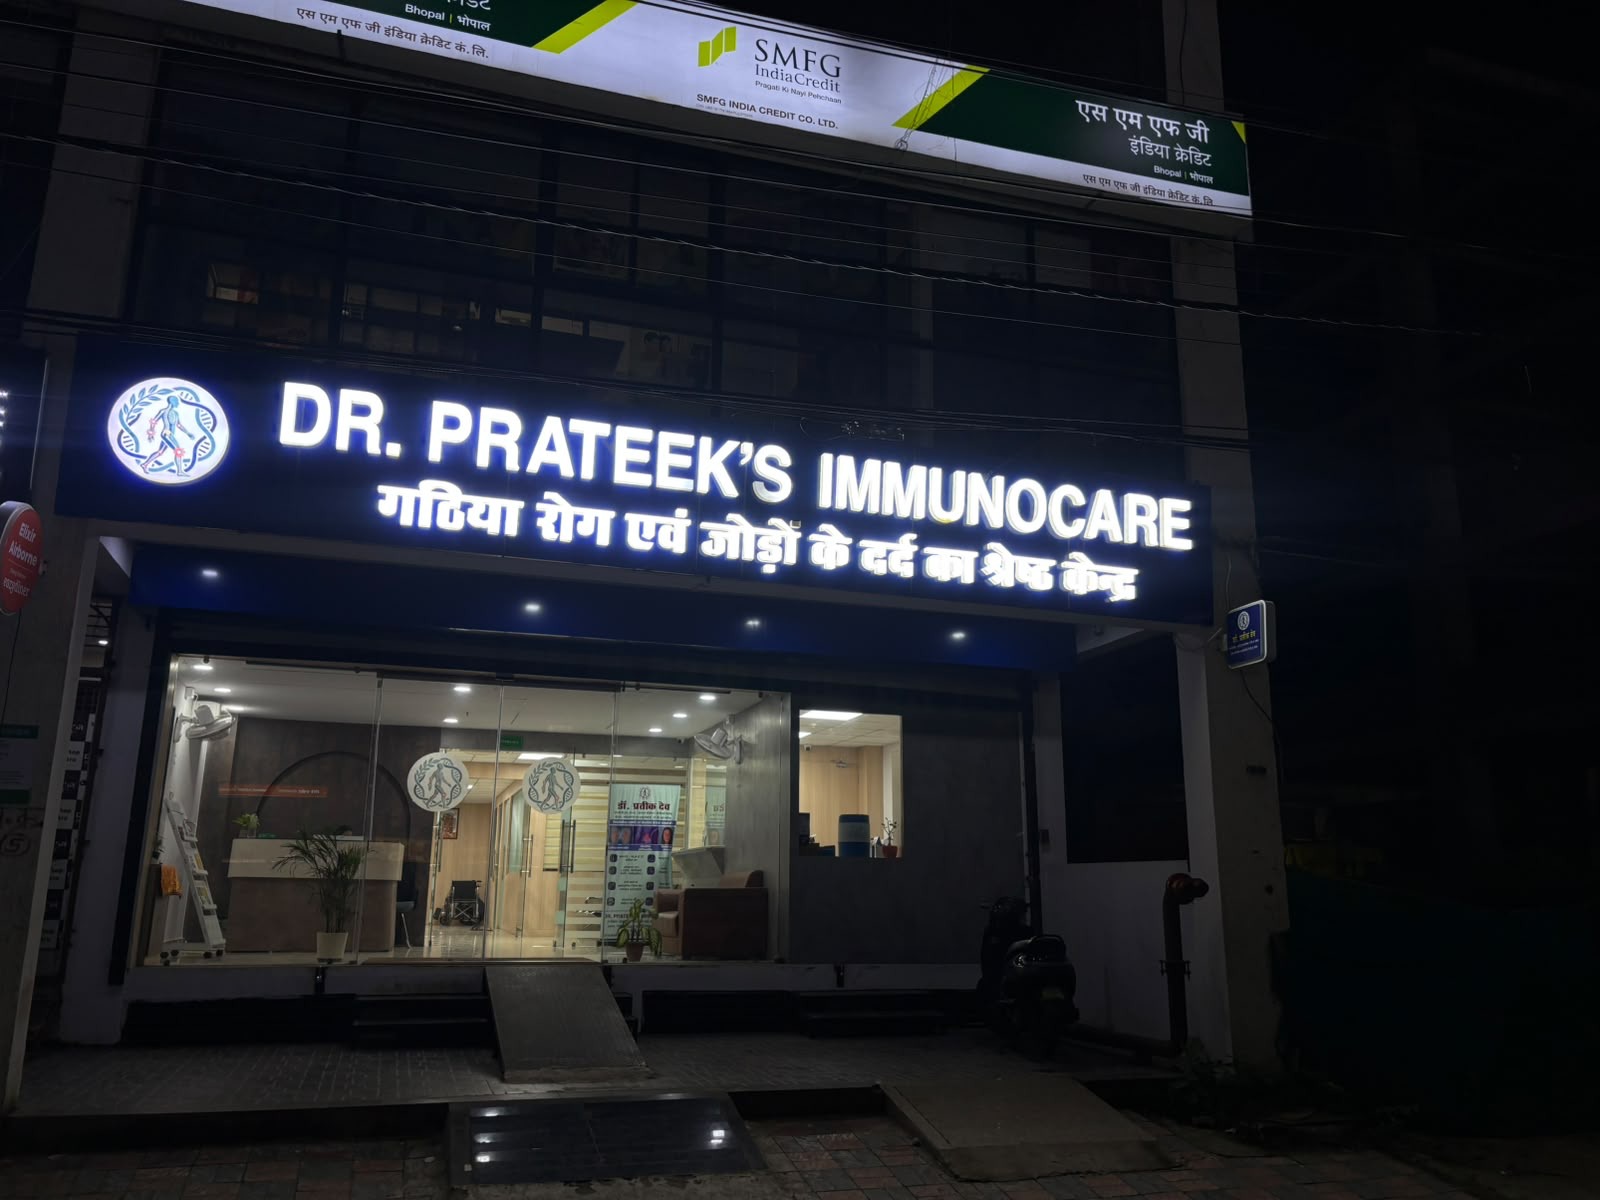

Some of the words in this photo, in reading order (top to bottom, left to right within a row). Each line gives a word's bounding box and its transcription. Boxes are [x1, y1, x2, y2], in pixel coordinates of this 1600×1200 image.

[405, 4, 445, 21] Bhopal
[457, 14, 491, 31] भोपाल
[297, 8, 315, 20] एस
[320, 13, 337, 25] एम
[342, 17, 361, 29] एफ
[365, 20, 381, 34] जी
[384, 25, 417, 42] इंडिया
[420, 33, 451, 50] क्रेडिट
[754, 39, 841, 78] SMFG
[755, 80, 780, 92] Pragati
[782, 85, 789, 93] Ki
[790, 88, 806, 98] Nayi
[808, 91, 842, 104] Pehchaan
[697, 93, 726, 107] SMFG
[729, 100, 757, 113] INDIA
[759, 105, 796, 121] CREDIT
[798, 114, 816, 125] CO.
[818, 118, 839, 130] LTD.
[1075, 99, 1108, 123] एस
[1113, 107, 1143, 131] एम
[1147, 115, 1181, 137] एफ
[1185, 119, 1210, 144] जी
[1128, 135, 1170, 160] इंडिया
[1174, 143, 1212, 167] क्रेडिट
[1153, 165, 1182, 179] Bhopal
[1189, 171, 1213, 185] भोपाल
[1083, 173, 1096, 183] एस
[1098, 177, 1111, 187] एम
[1114, 180, 1128, 191] एफ
[1130, 183, 1141, 193] जी
[1143, 185, 1166, 198] इंडिया
[1167, 188, 1190, 202] क्रेडिट
[279, 381, 402, 458] DR.
[428, 400, 793, 503] PRATEEK'S
[817, 452, 1194, 551] IMMUNOCARE
[19, 522, 37, 543] Elixir
[377, 479, 525, 537] गठिया
[536, 491, 616, 546] रोग
[625, 508, 692, 554] एवं
[808, 523, 852, 570] के
[859, 533, 919, 577] दर्द
[923, 546, 978, 584] का
[9, 541, 38, 567] Airborne
